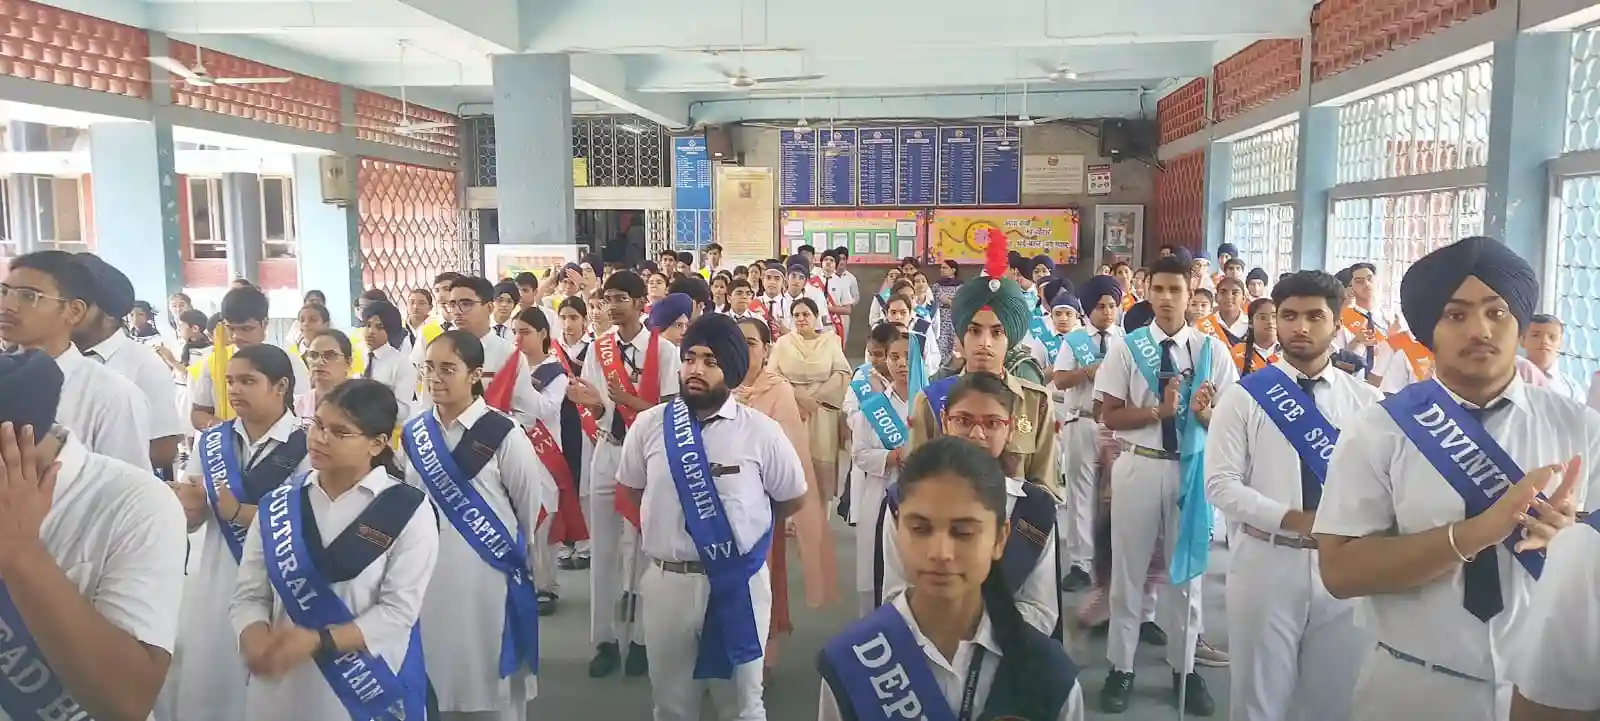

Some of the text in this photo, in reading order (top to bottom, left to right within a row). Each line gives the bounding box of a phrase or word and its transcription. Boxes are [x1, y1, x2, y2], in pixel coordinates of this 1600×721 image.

[1265, 384, 1335, 460] VICE SPO
[1413, 404, 1513, 499] DIVINIT
[680, 451, 717, 520] CAPTAIN
[269, 484, 319, 611] CULTURAL
[463, 507, 514, 559] CAPTAIN
[704, 540, 733, 561] VV
[334, 651, 384, 704] PTAIN
[852, 632, 928, 721] DEP
